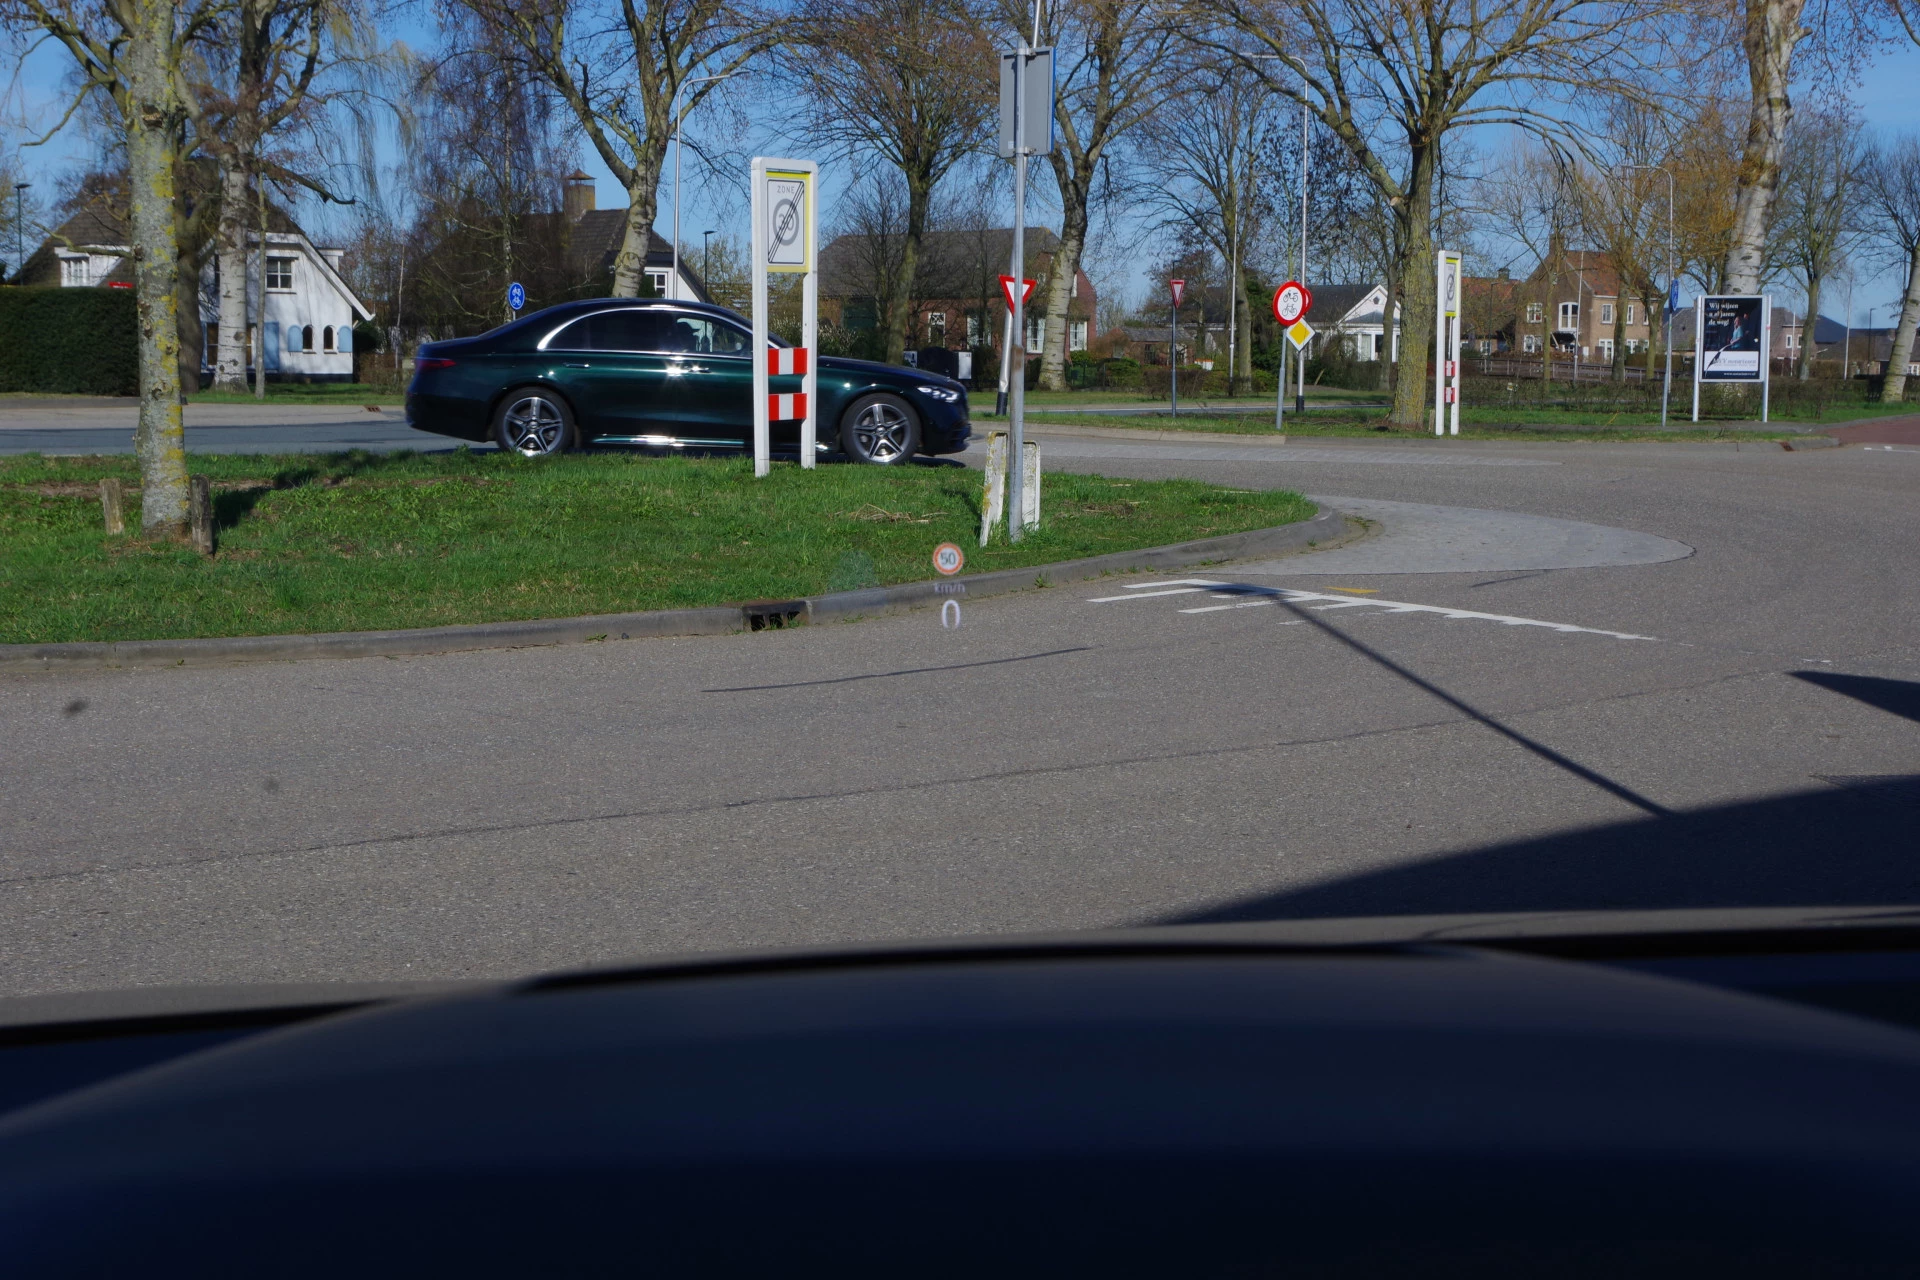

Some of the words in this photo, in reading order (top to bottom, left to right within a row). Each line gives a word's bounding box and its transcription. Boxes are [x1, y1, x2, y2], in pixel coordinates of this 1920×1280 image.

[777, 185, 795, 194] ZONE
[1709, 302, 1720, 310] Wij
[1721, 302, 1739, 310] wijzen
[1708, 318, 1716, 326] de
[940, 552, 956, 566] 50
[934, 582, 966, 594] km/h
[941, 599, 961, 629] 0
